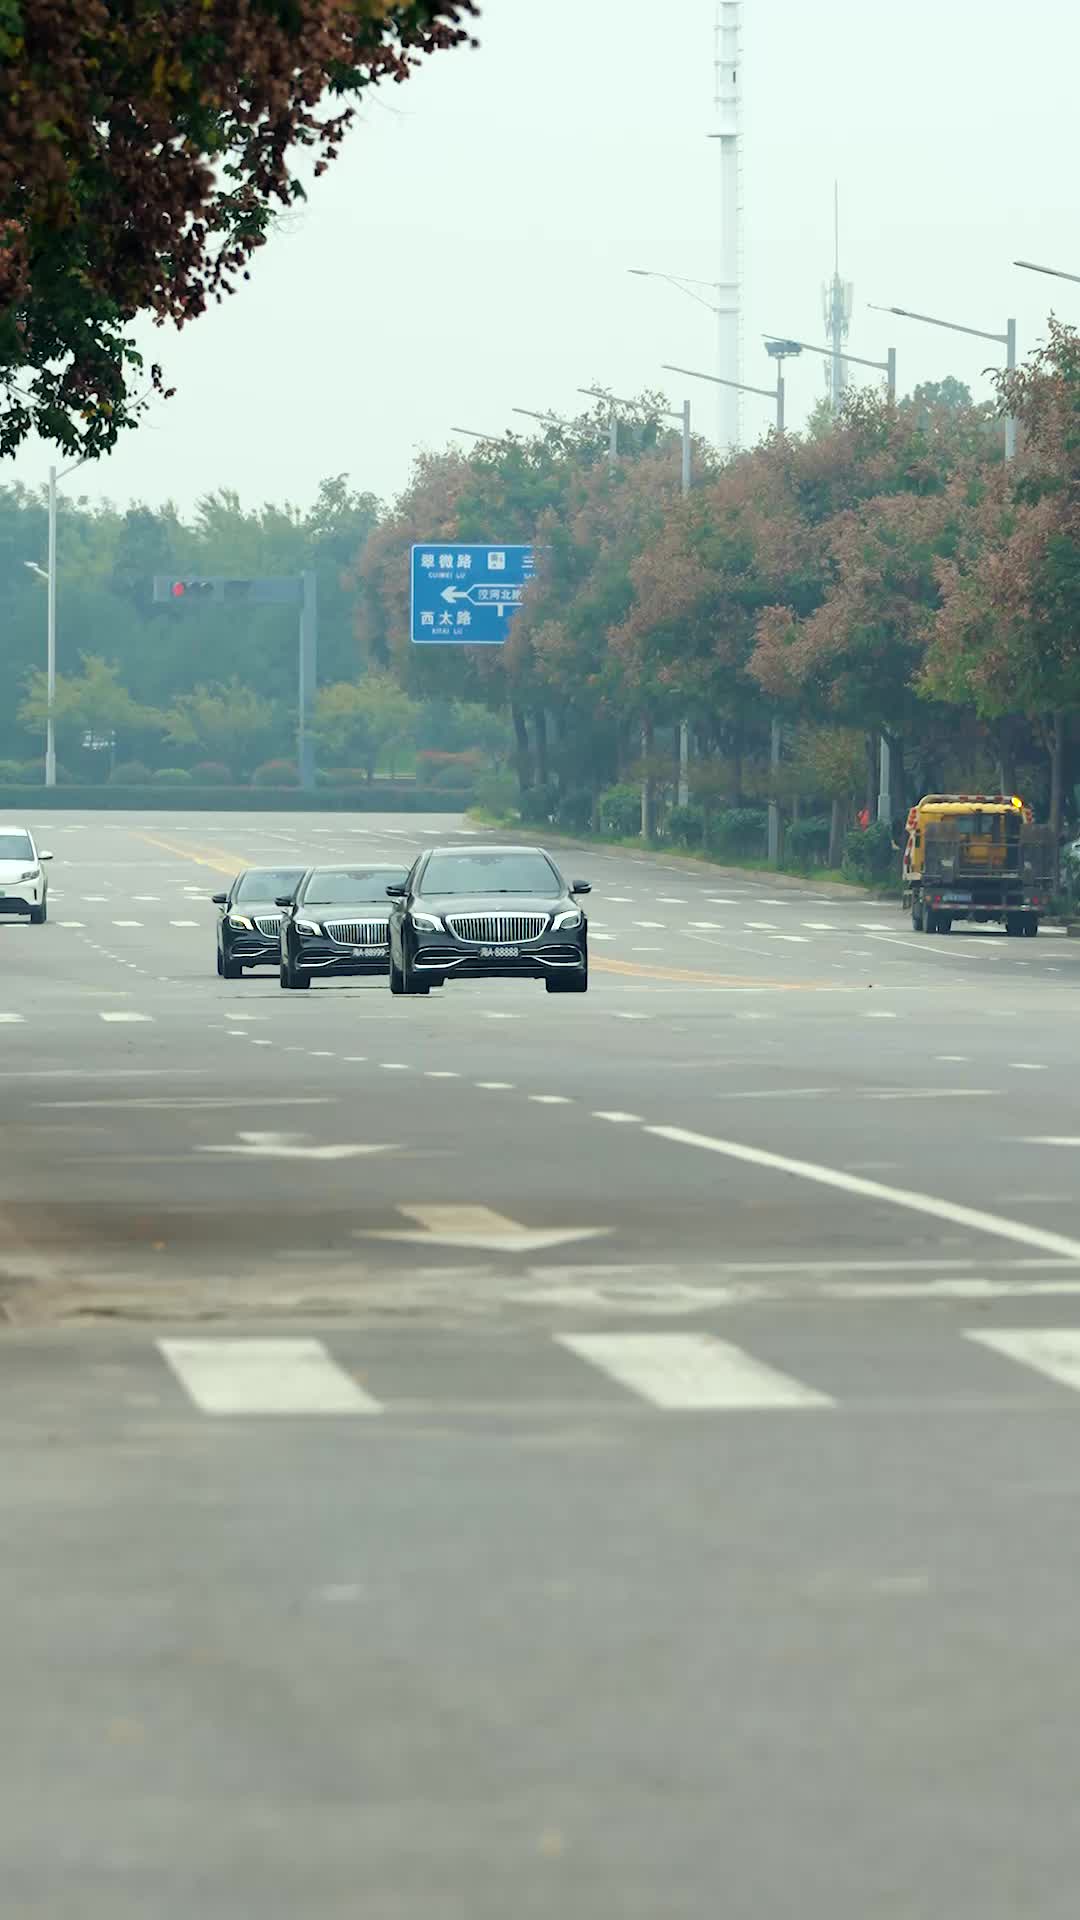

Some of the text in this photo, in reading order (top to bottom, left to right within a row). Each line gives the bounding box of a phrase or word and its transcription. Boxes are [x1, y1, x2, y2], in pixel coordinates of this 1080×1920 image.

[421, 554, 472, 569] 翠微路
[420, 610, 472, 625] 西太路
